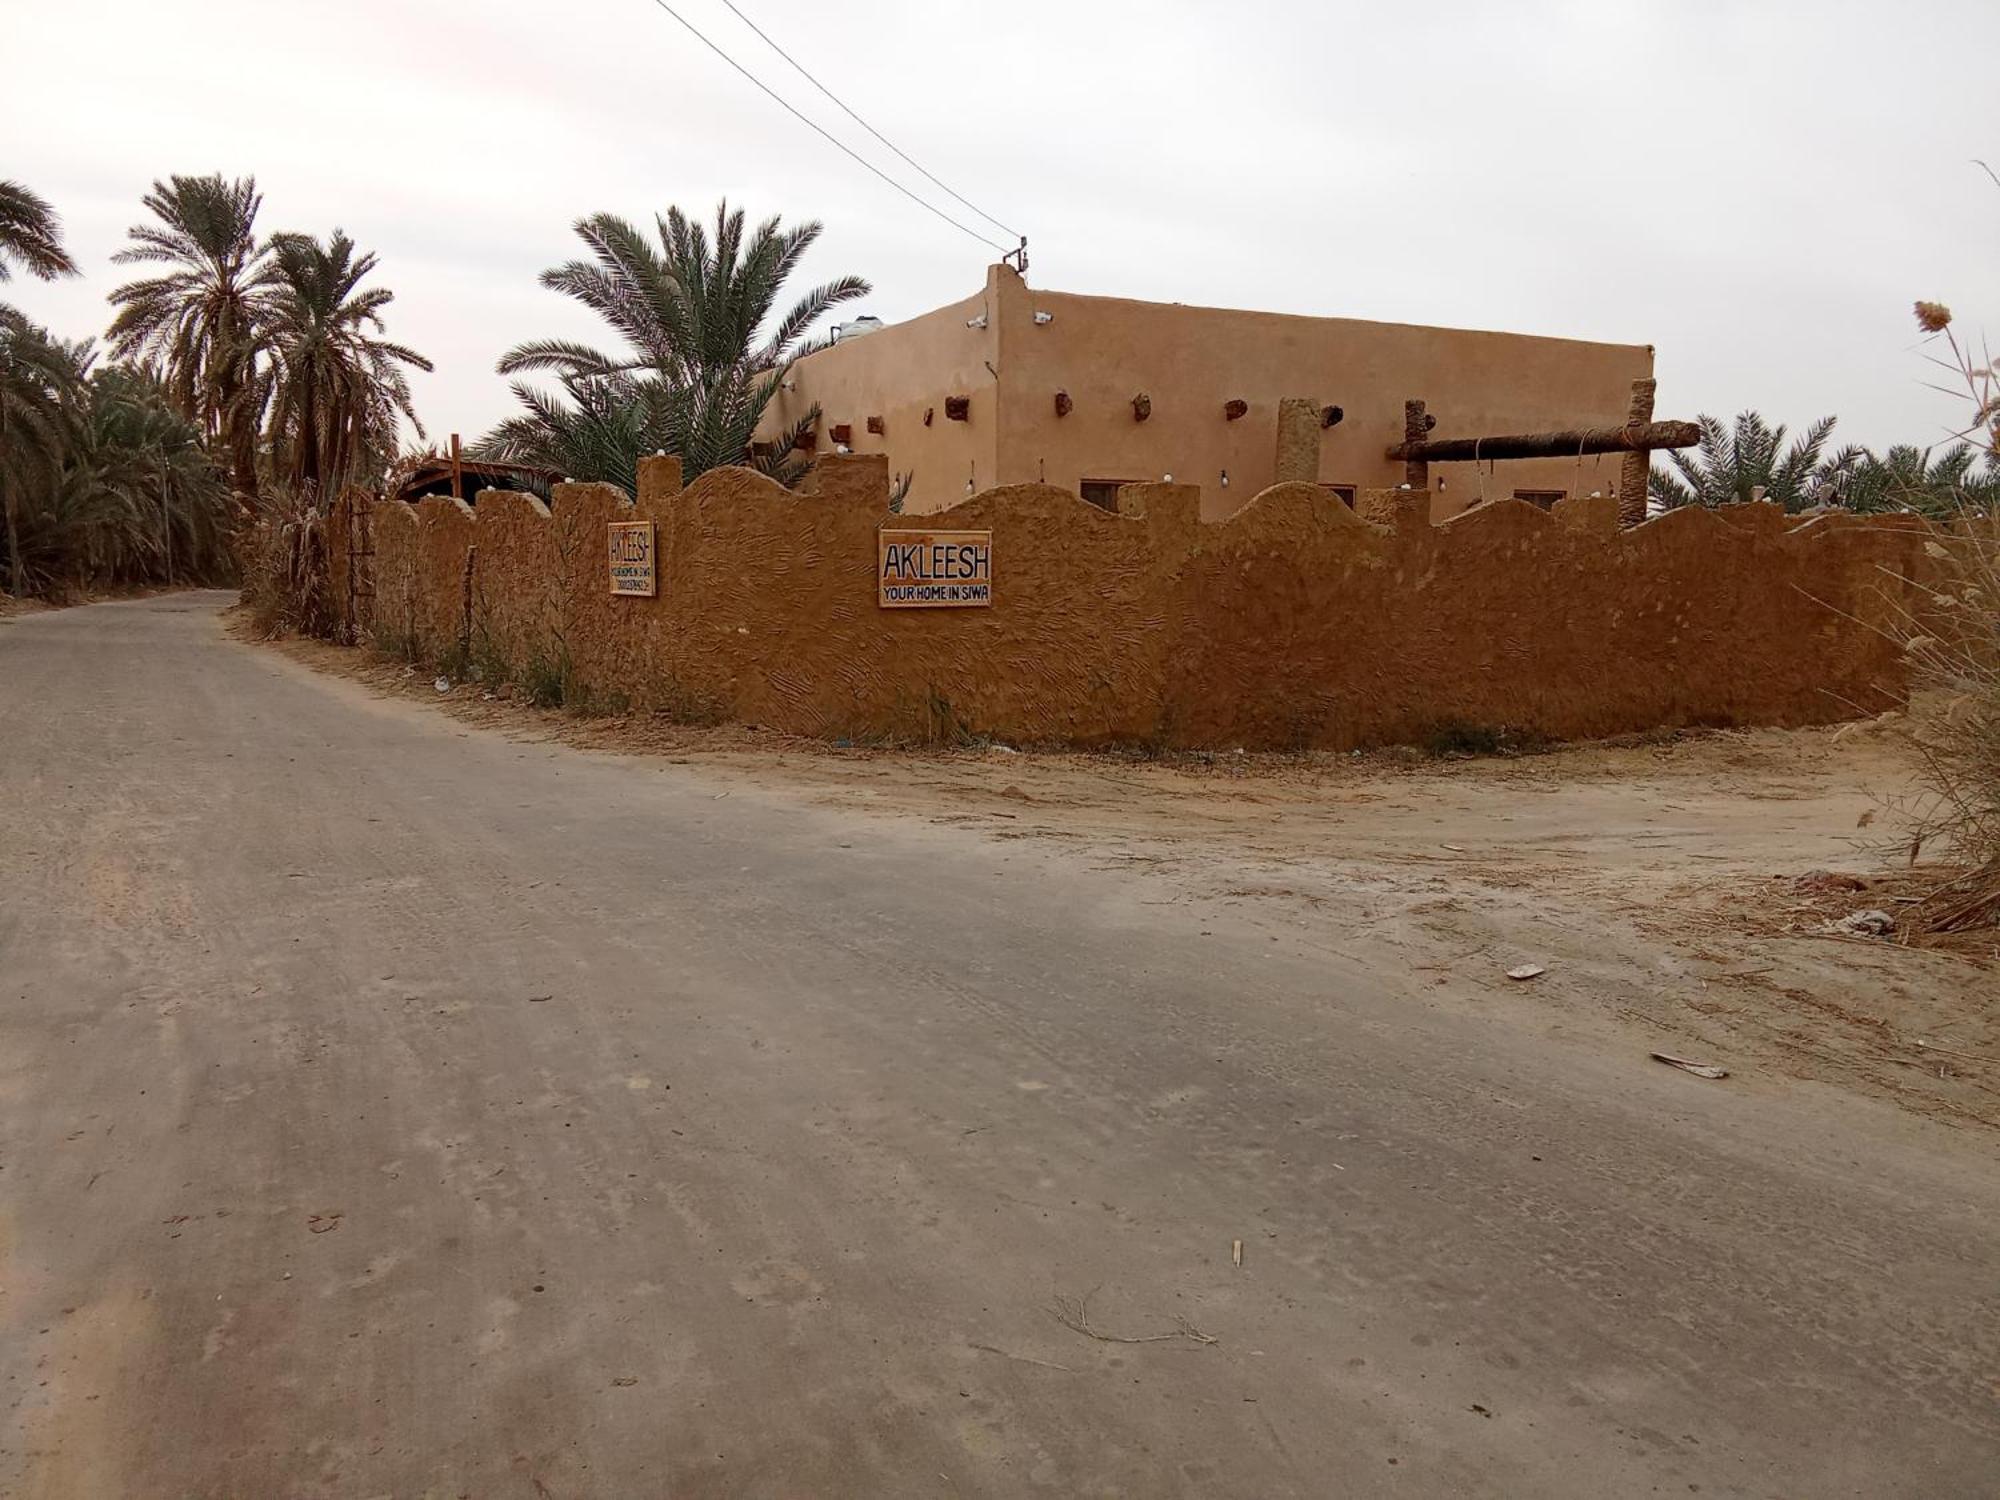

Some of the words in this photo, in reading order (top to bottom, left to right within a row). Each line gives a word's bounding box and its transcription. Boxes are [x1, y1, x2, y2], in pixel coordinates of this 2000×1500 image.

[883, 544, 988, 579] AKLEESH
[883, 587, 914, 601] YOUR
[916, 587, 947, 600] HOME
[948, 586, 960, 600] IN
[962, 586, 988, 601] SIWA
